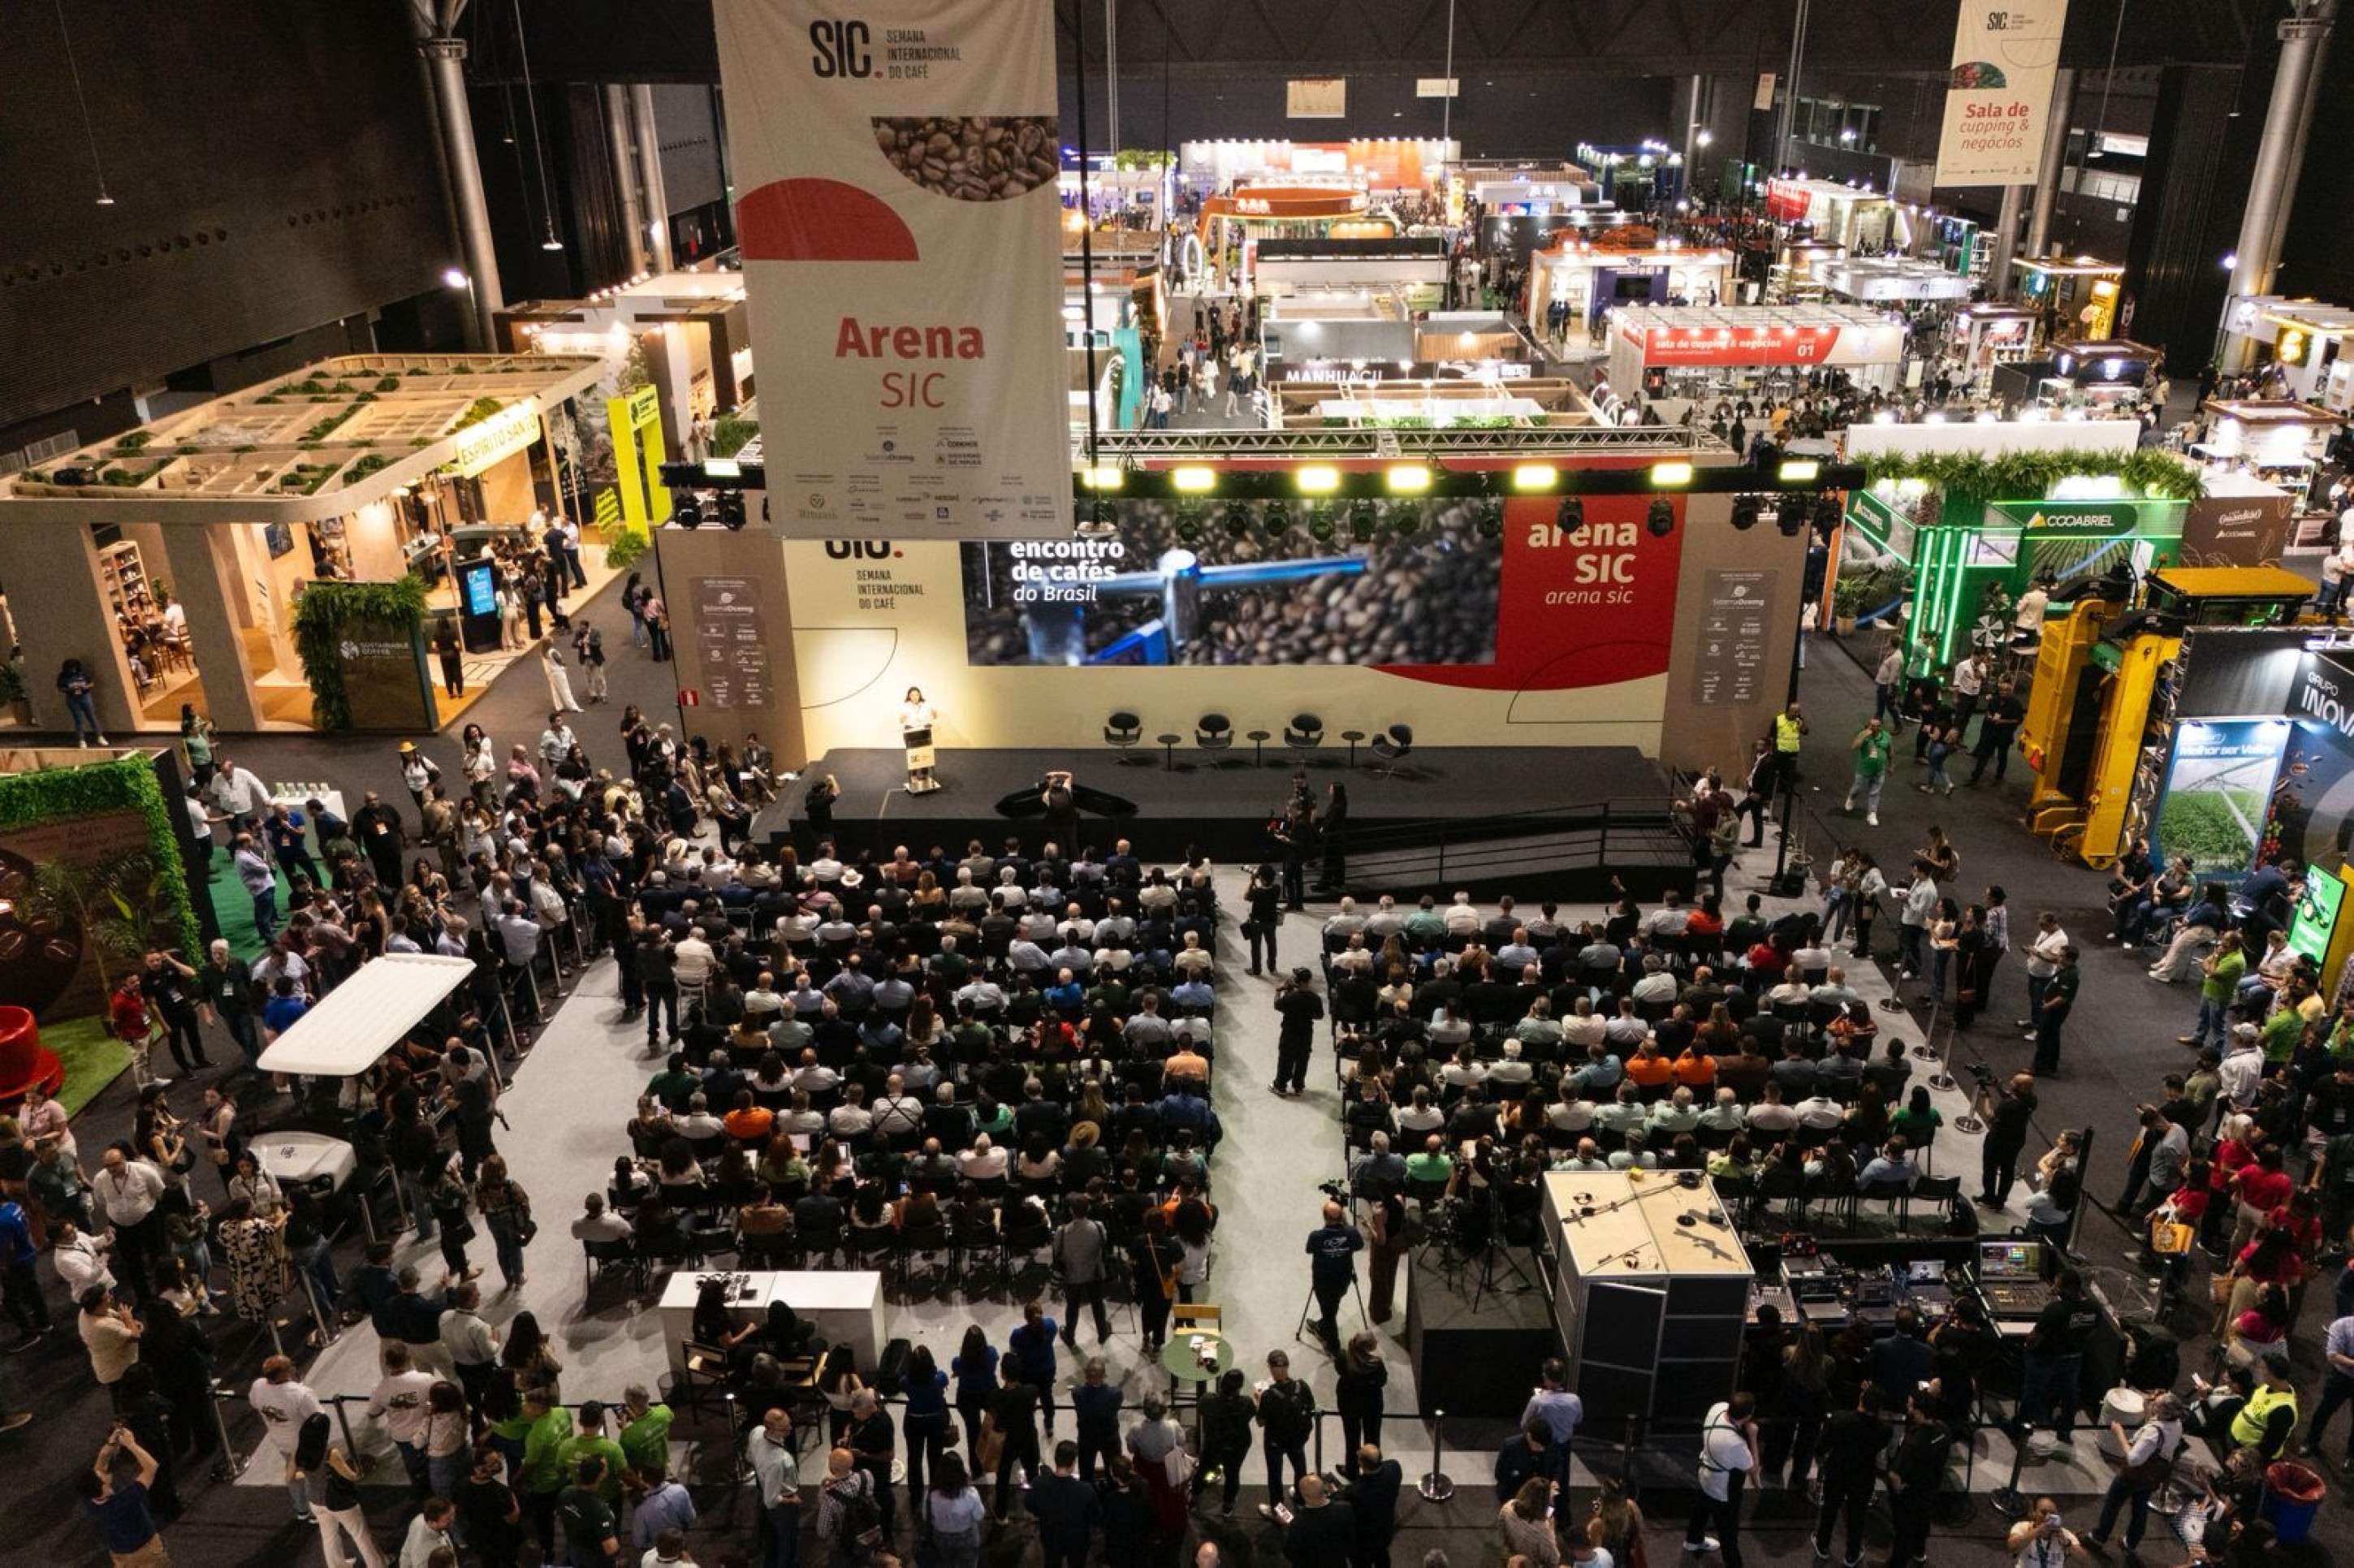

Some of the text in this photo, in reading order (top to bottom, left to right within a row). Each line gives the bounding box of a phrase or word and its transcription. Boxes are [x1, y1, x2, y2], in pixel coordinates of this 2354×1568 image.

[887, 29, 925, 43] SEMANA
[810, 20, 883, 78] SIC.
[888, 47, 961, 61] INTERNACIONAL
[889, 63, 928, 79] DO CAFÉ
[1966, 102, 2029, 118] Sala de
[1959, 119, 2030, 136] cupping &
[1962, 136, 2023, 152] negócios
[836, 317, 985, 360] Arena
[1797, 344, 1815, 356] 01
[880, 371, 946, 408] SIC
[1010, 539, 1125, 559] encontro
[856, 570, 892, 581] SEMANA
[1012, 558, 1118, 581] de cafés
[1574, 554, 1637, 584] SIC
[857, 584, 924, 594] INTERNACIONAL
[1014, 585, 1098, 601] do Brasil
[1545, 585, 1634, 604] arena sic
[859, 597, 895, 609] DO CAFÉ
[2308, 672, 2339, 696] GRUPO
